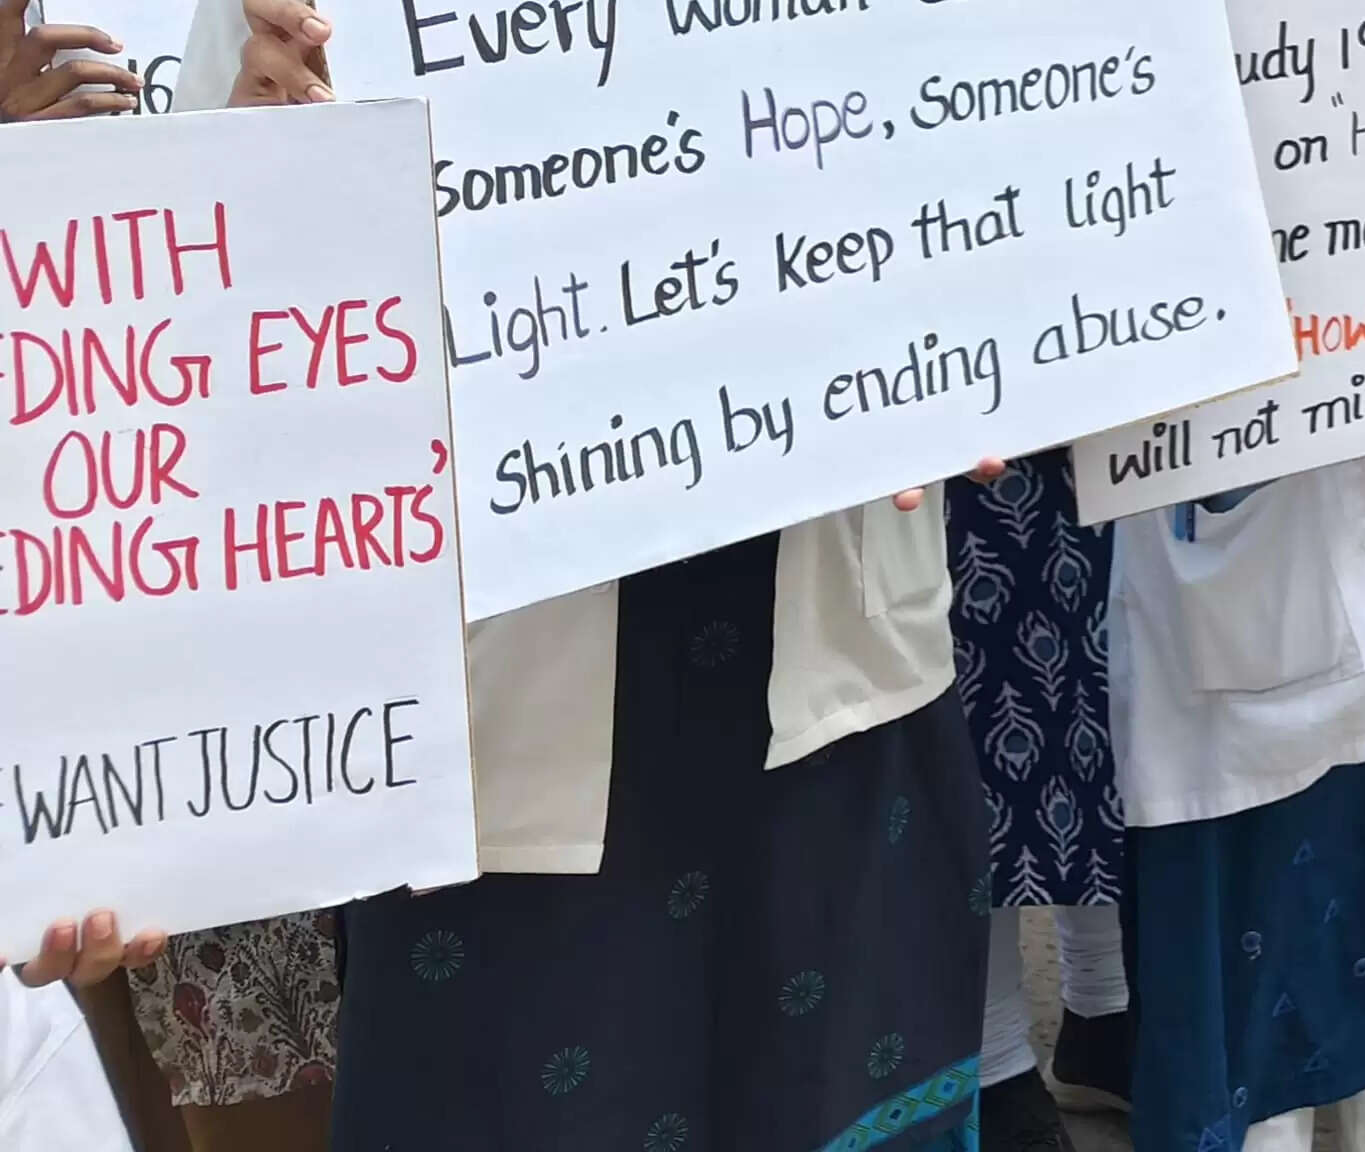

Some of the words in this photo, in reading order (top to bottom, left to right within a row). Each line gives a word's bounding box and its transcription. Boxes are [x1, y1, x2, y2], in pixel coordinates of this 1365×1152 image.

[739, 85, 896, 171] Hope,
[1273, 135, 1329, 171] on
[0, 200, 233, 309] WITH
[619, 236, 741, 328] Let's
[910, 182, 1025, 261] that
[1064, 156, 1178, 241] light
[0, 317, 212, 428] DING
[248, 294, 419, 397] EYES
[720, 385, 796, 456] by
[821, 331, 1004, 423] ending
[1031, 291, 1228, 369] abuse.
[43, 422, 199, 519] OUR
[1108, 410, 1193, 486] will
[1210, 397, 1282, 461] not
[0, 515, 200, 616] DING
[13, 734, 178, 845] WANT
[187, 699, 420, 821] JUSTICE
